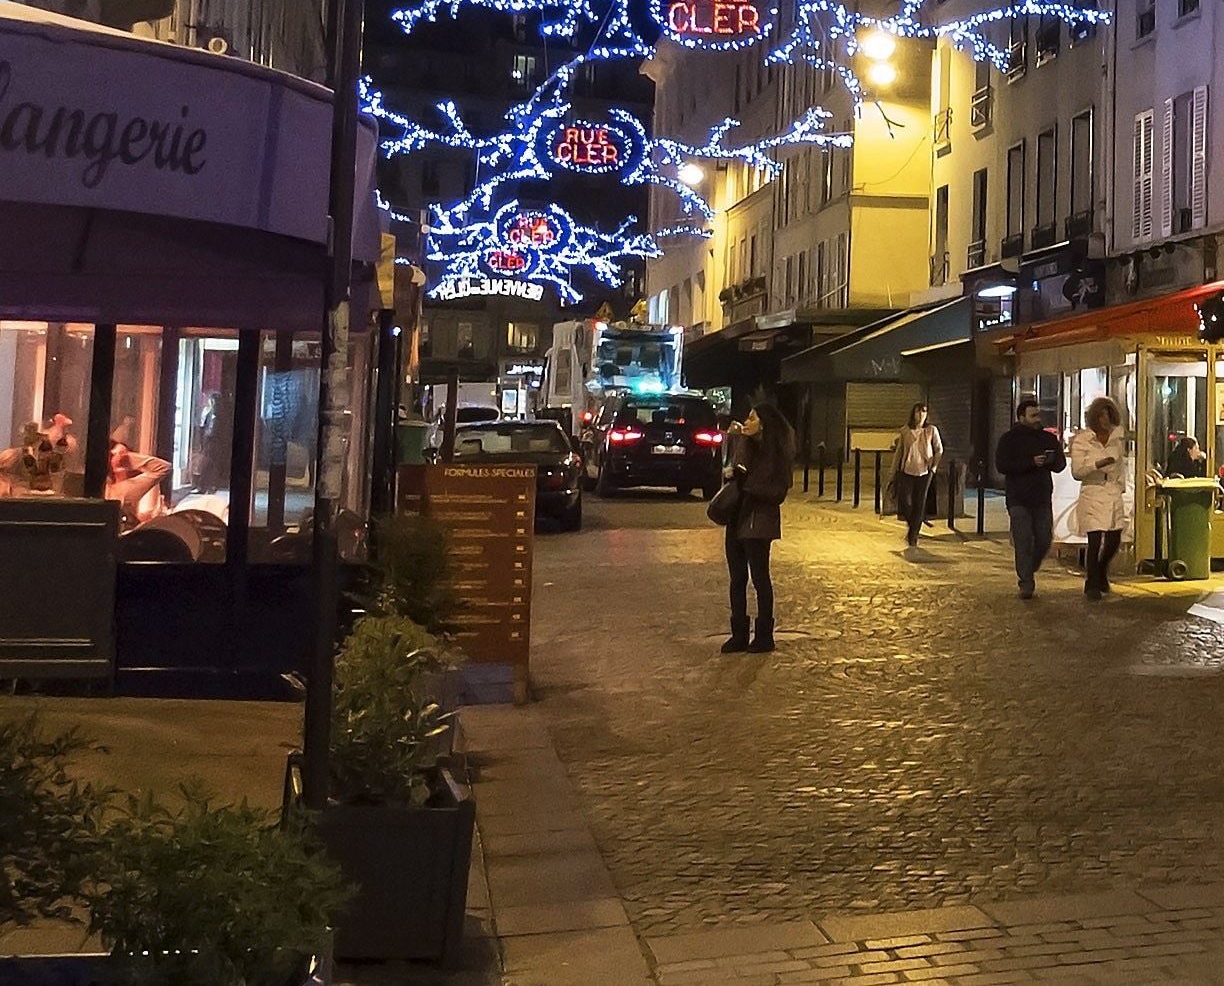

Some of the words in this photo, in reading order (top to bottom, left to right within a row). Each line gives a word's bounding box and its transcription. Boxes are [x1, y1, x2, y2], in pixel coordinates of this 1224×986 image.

[668, 2, 761, 33] CLER
[565, 128, 609, 145] RUE
[557, 142, 618, 164] CLER
